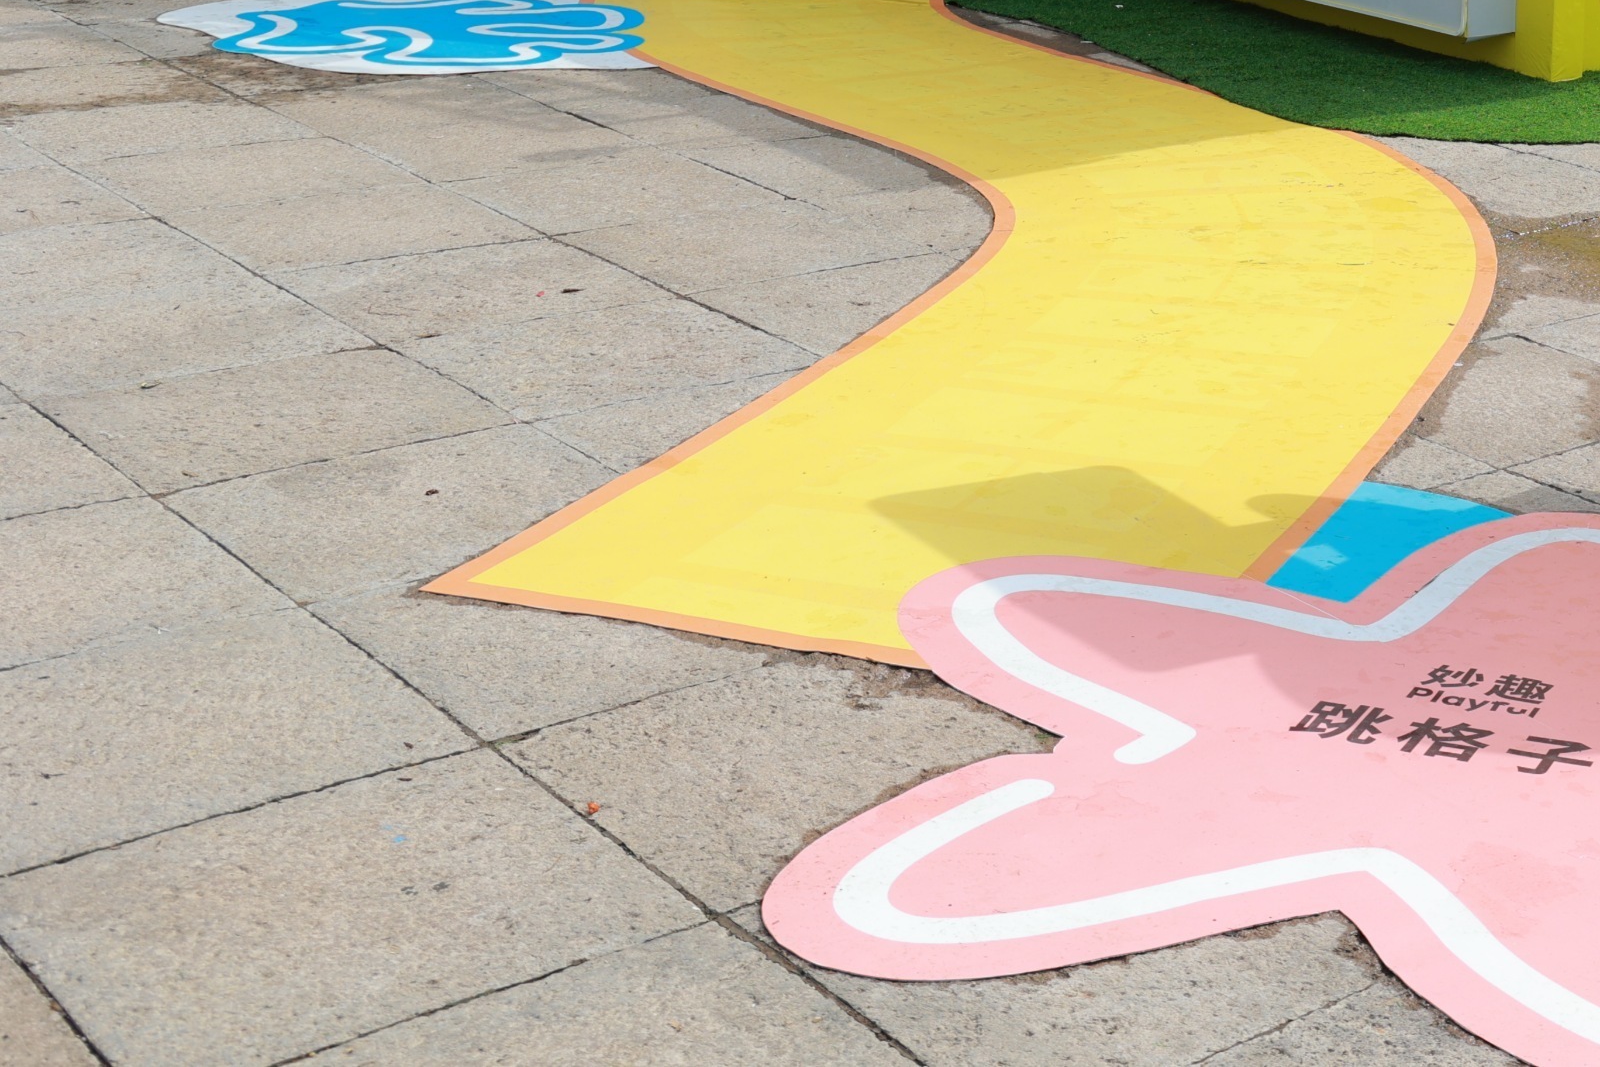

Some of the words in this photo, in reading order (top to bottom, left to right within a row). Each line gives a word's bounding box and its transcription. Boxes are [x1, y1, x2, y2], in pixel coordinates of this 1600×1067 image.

[1406, 686, 1541, 719] Playful
[1421, 664, 1554, 704] 妙趣
[1288, 700, 1594, 774] 跳格子
